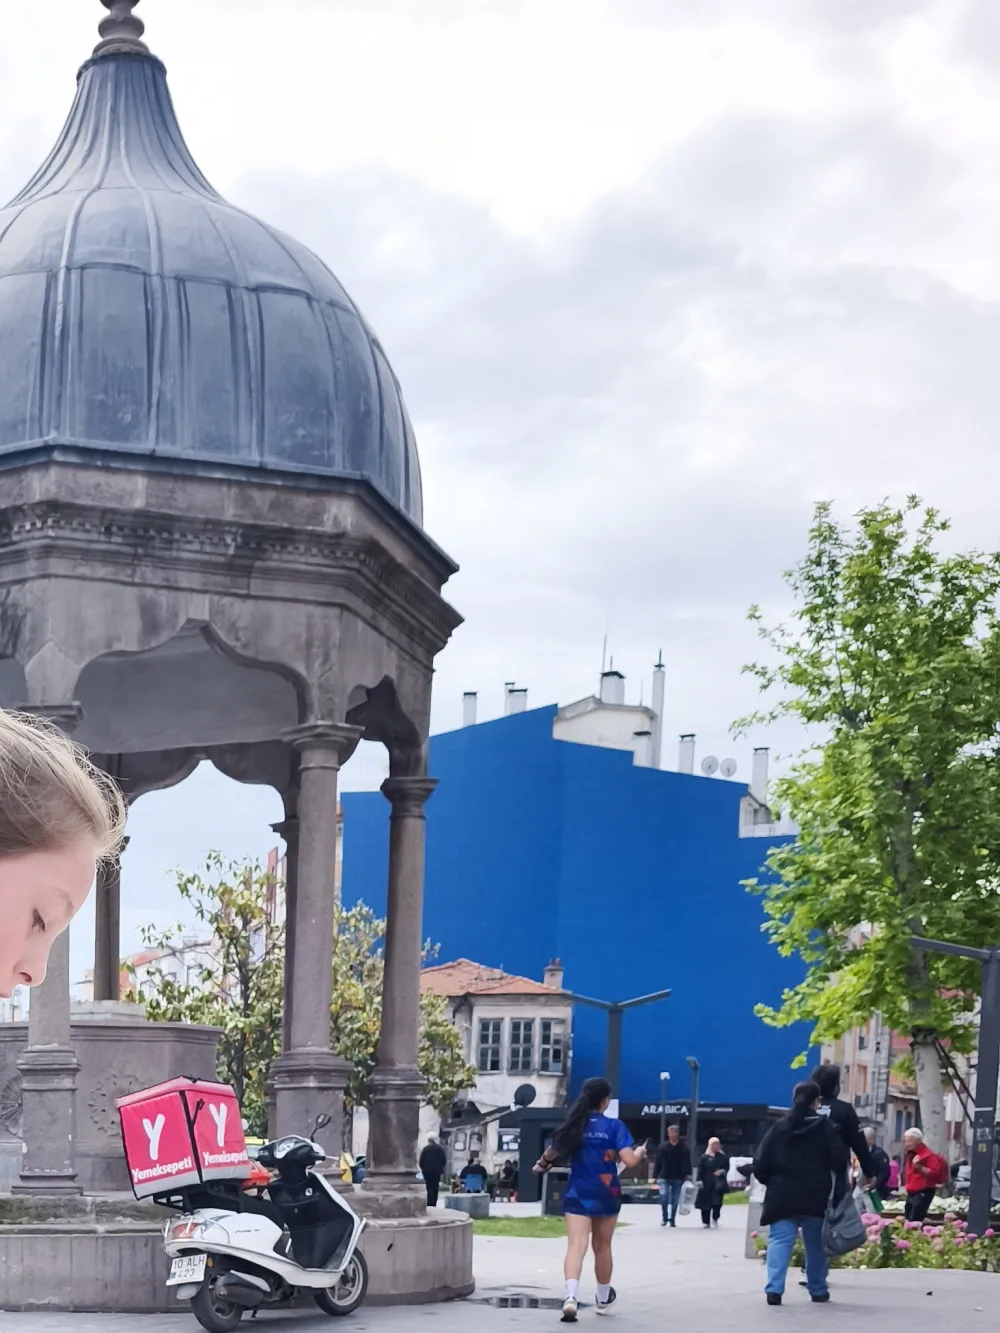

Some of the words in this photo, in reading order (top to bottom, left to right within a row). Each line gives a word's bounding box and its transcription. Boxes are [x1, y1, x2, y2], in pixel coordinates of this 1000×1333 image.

[640, 1104, 690, 1116] ARABICA
[202, 1149, 248, 1167] Yemeksepeti
[131, 1155, 192, 1183] Yemeksepeti
[174, 1258, 184, 1270] 10
[187, 1255, 206, 1268] ALH
